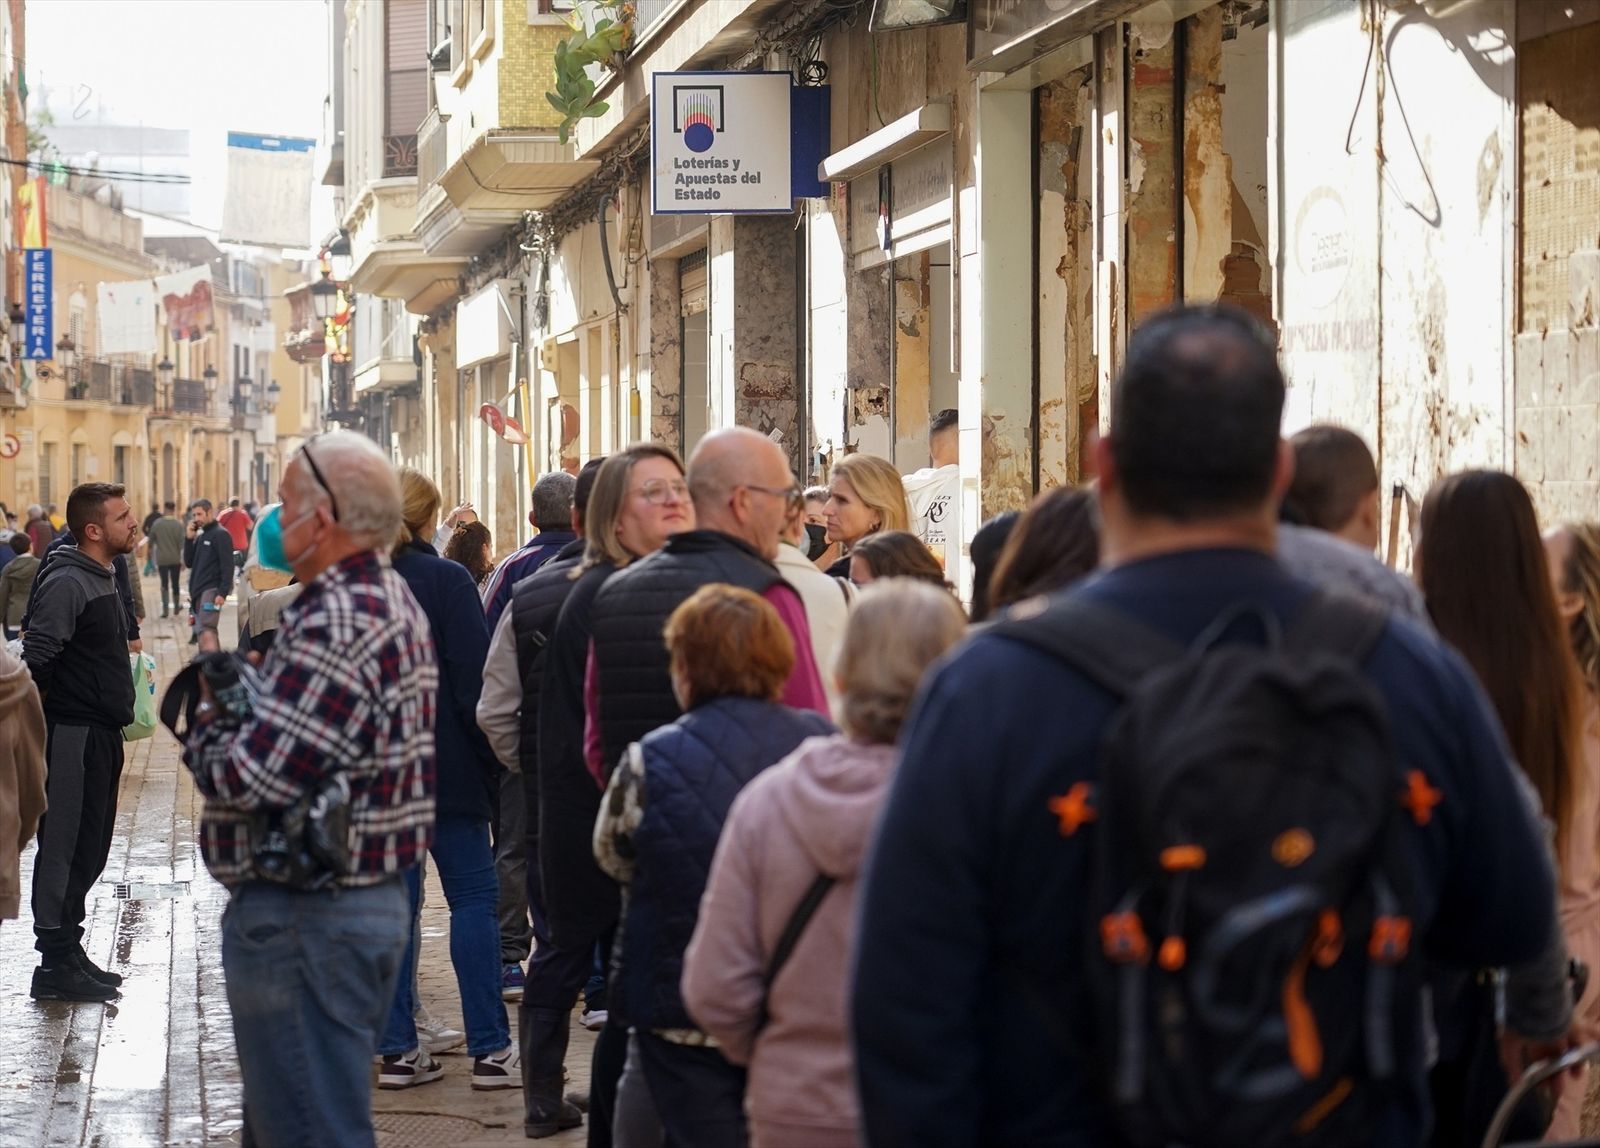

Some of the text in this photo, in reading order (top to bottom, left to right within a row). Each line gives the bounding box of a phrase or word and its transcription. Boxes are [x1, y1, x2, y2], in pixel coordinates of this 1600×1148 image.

[674, 156, 741, 171] Loterías y
[675, 171, 761, 187] Apuestas del
[674, 187, 721, 200] Estado
[31, 250, 47, 358] FERRETERIA
